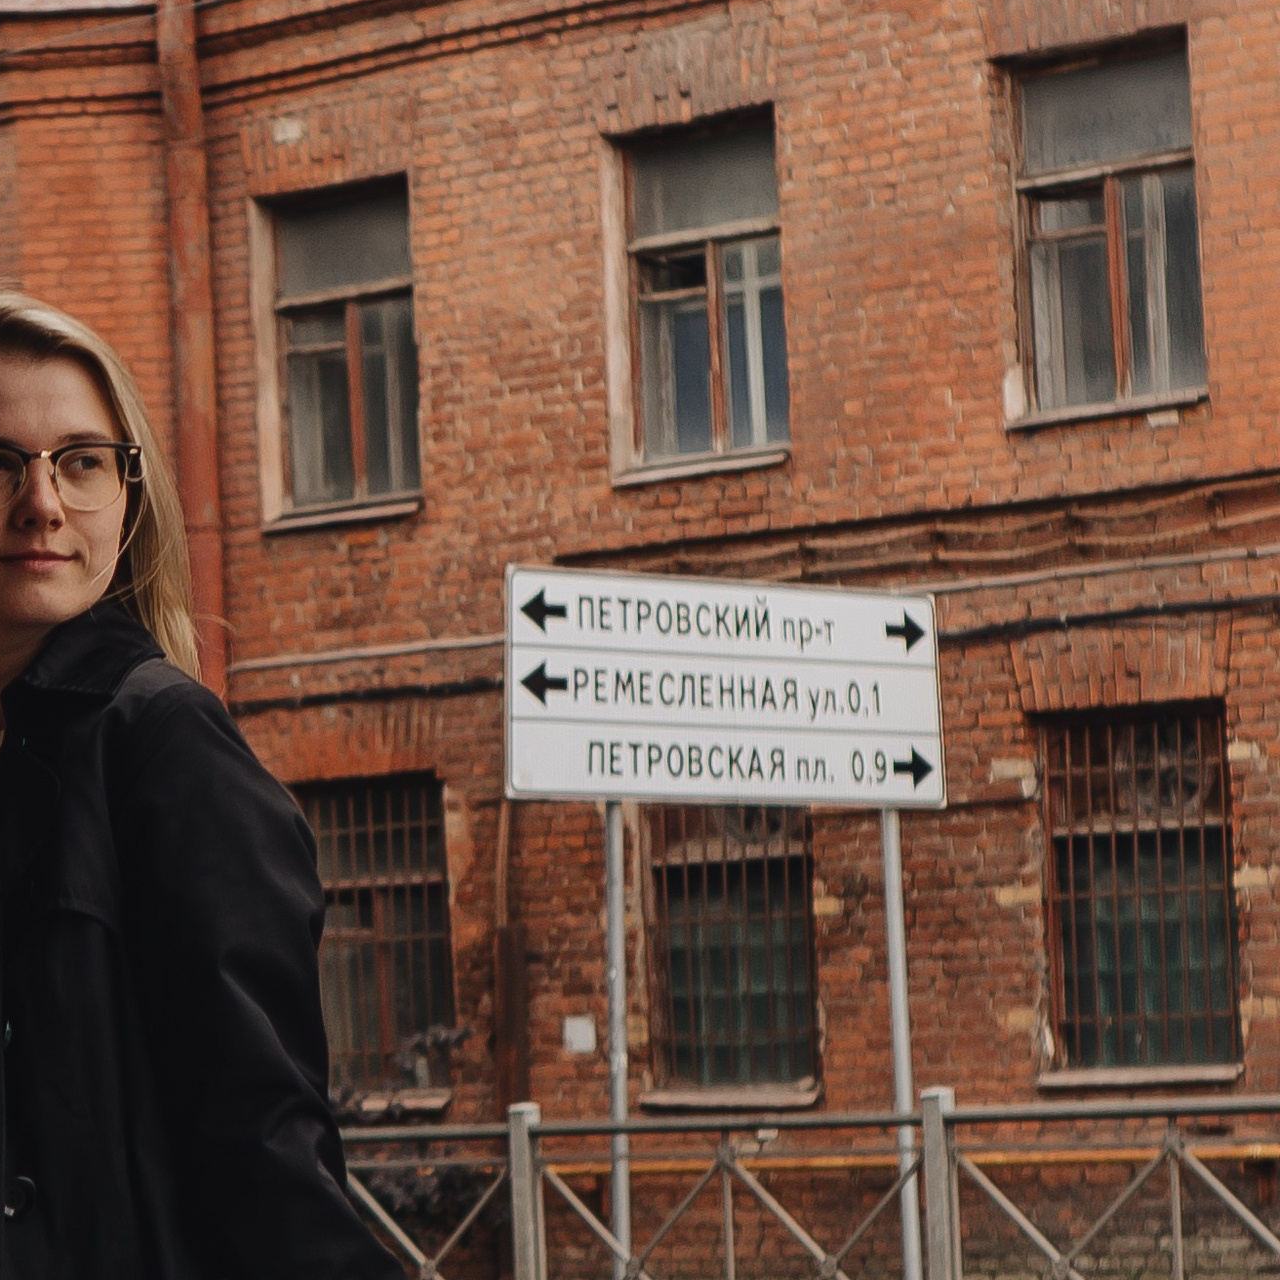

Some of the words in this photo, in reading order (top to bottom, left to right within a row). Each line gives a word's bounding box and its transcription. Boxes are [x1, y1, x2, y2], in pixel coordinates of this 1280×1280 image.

[578, 595, 771, 640] ПЕТРОВСКИЙ
[782, 616, 835, 652] пр-т
[573, 667, 799, 712] РЕМЕСЛЕННАЯ
[588, 740, 786, 782] ПЕТРОВСКАЯ
[796, 757, 835, 783] пл.
[851, 749, 887, 785] 0,9
